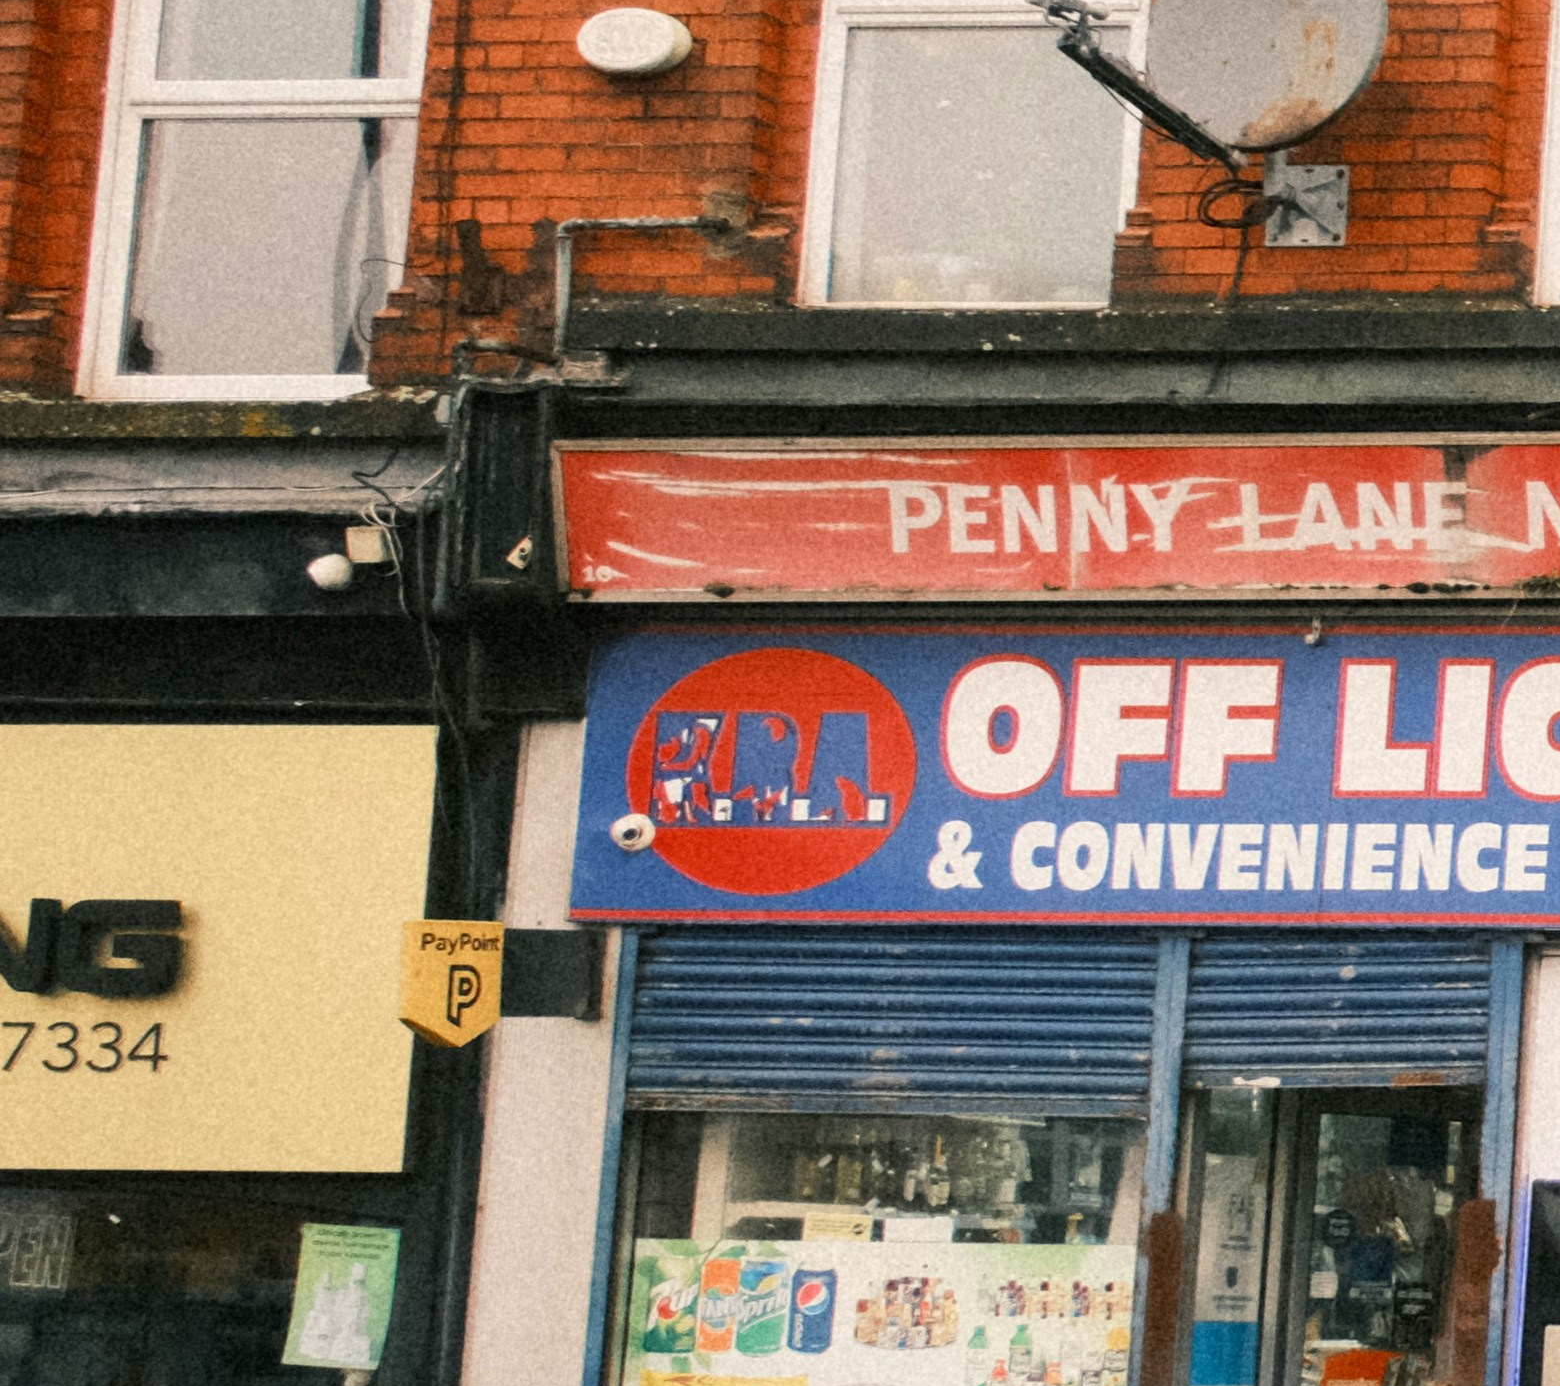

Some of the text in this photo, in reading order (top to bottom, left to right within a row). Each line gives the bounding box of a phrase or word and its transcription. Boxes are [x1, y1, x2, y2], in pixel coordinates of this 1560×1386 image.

[889, 481, 1188, 554] PENNY
[1240, 481, 1467, 552] LANE
[941, 653, 1283, 799] OFF
[928, 820, 984, 890] &
[1011, 821, 1549, 892] CONVENIENCE
[421, 932, 501, 955] PayPoint
[2, 1021, 168, 1072] 7334
